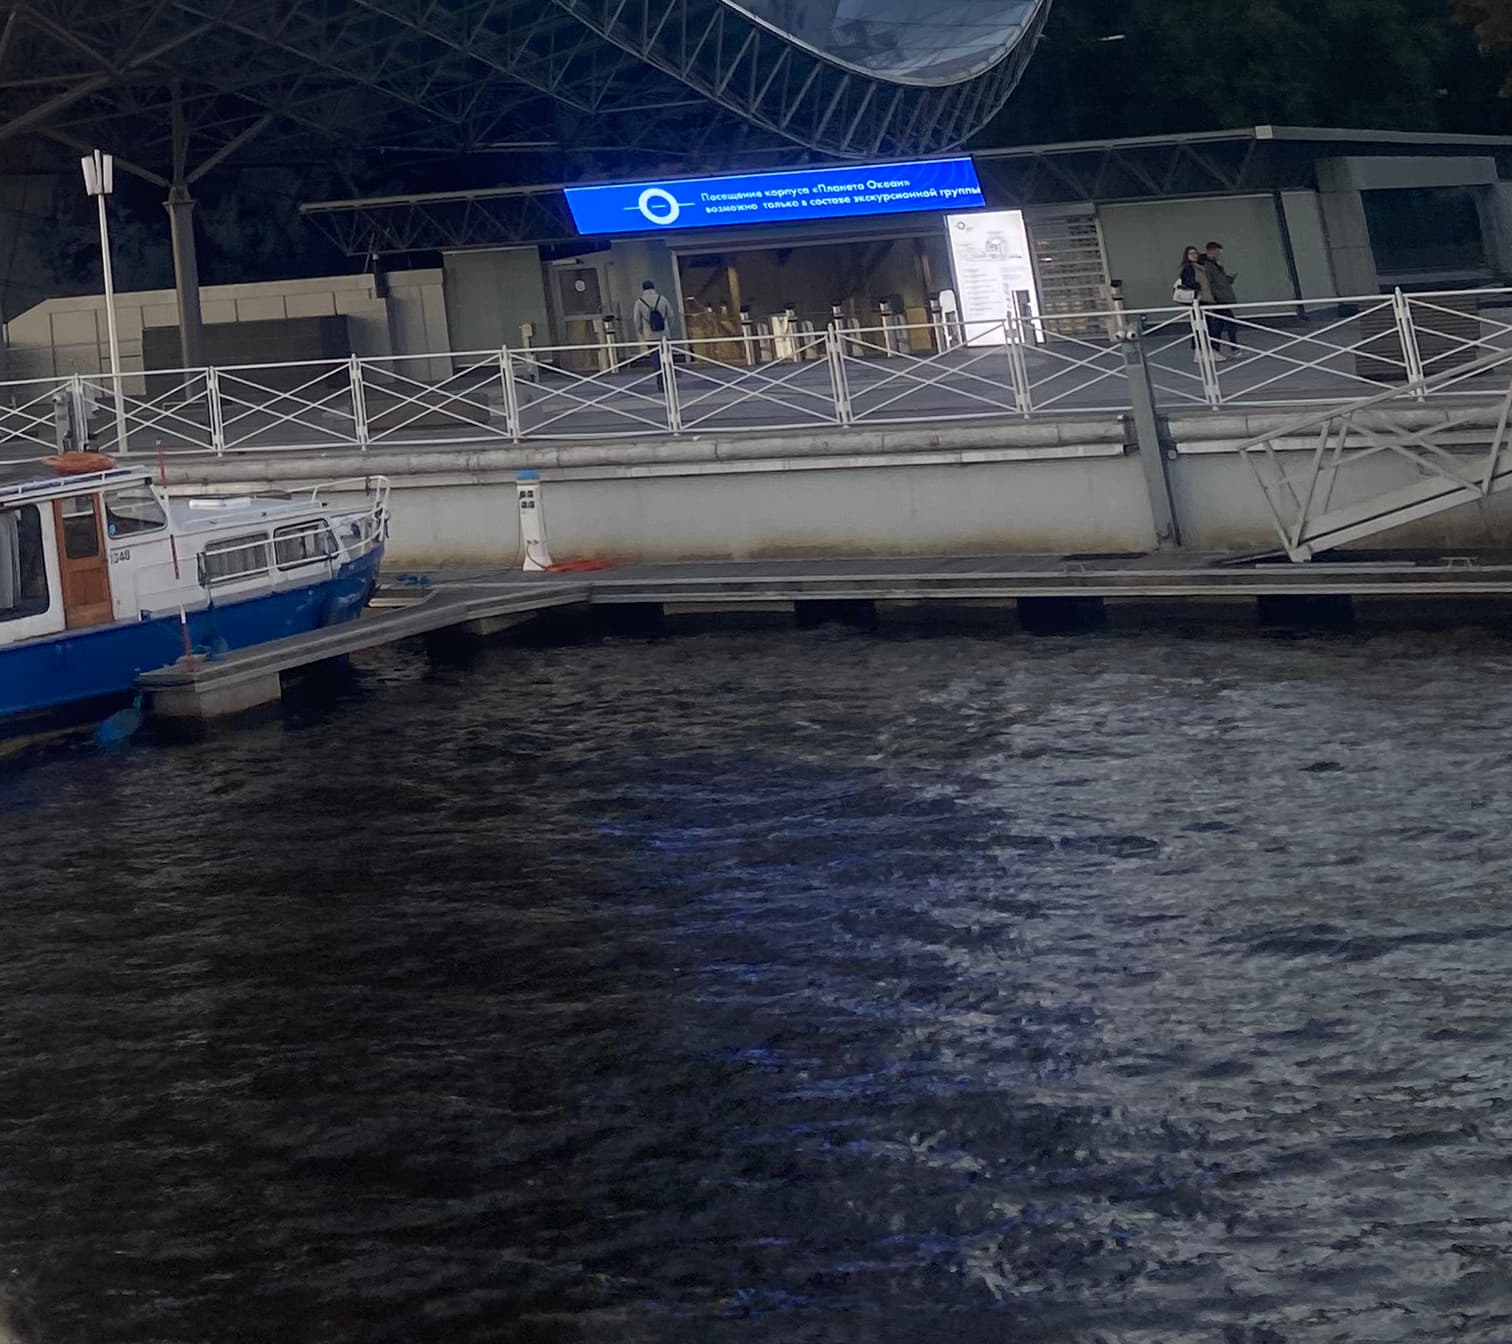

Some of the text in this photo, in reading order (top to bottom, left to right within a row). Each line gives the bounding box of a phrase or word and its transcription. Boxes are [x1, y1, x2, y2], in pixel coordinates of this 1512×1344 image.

[701, 179, 911, 202] Посещение корпуса «Планета Океан»
[705, 203, 759, 213] возможно
[763, 200, 799, 209] только
[810, 196, 851, 206] составе
[853, 188, 938, 204] экскурсионной
[939, 186, 981, 199] группы
